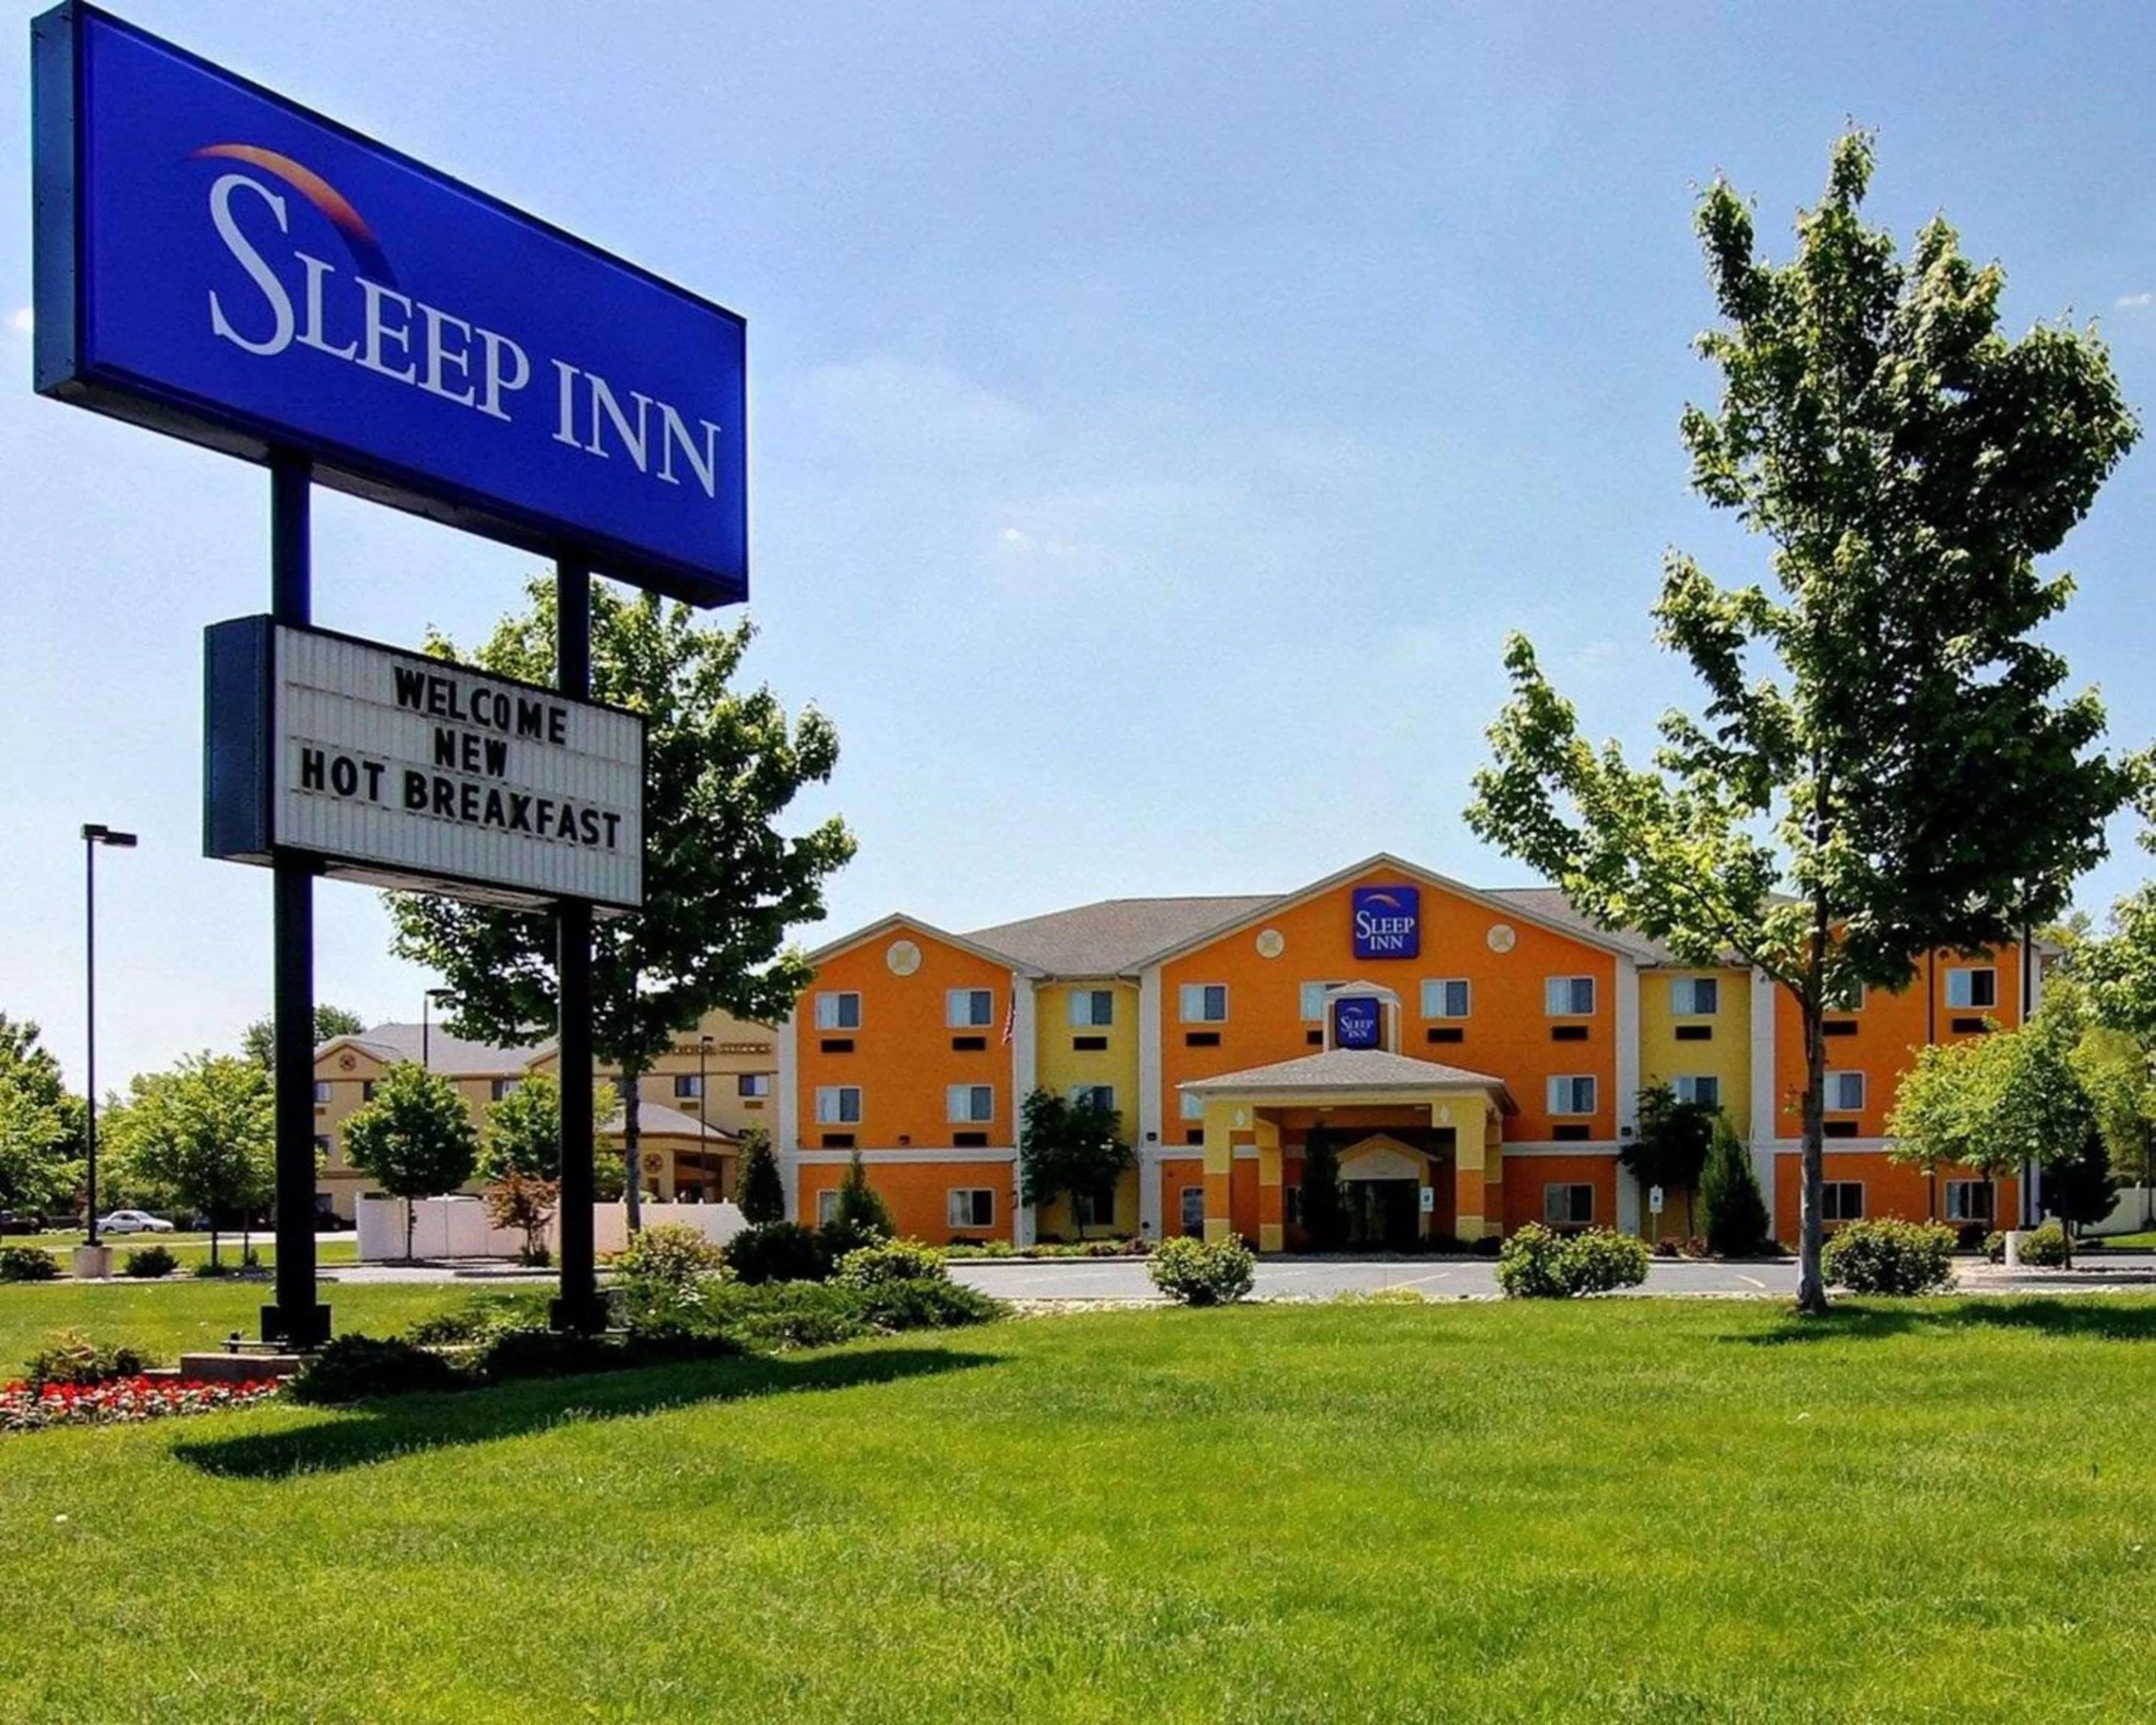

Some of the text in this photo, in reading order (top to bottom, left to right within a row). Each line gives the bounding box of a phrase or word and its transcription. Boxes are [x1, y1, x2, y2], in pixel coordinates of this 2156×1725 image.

[209, 173, 721, 499] SLEEP INN
[394, 666, 567, 746] WELCOME
[302, 747, 385, 802] HOT
[435, 727, 508, 778] NEW
[1356, 910, 1415, 939] SLEEP
[1370, 935, 1404, 951] INN
